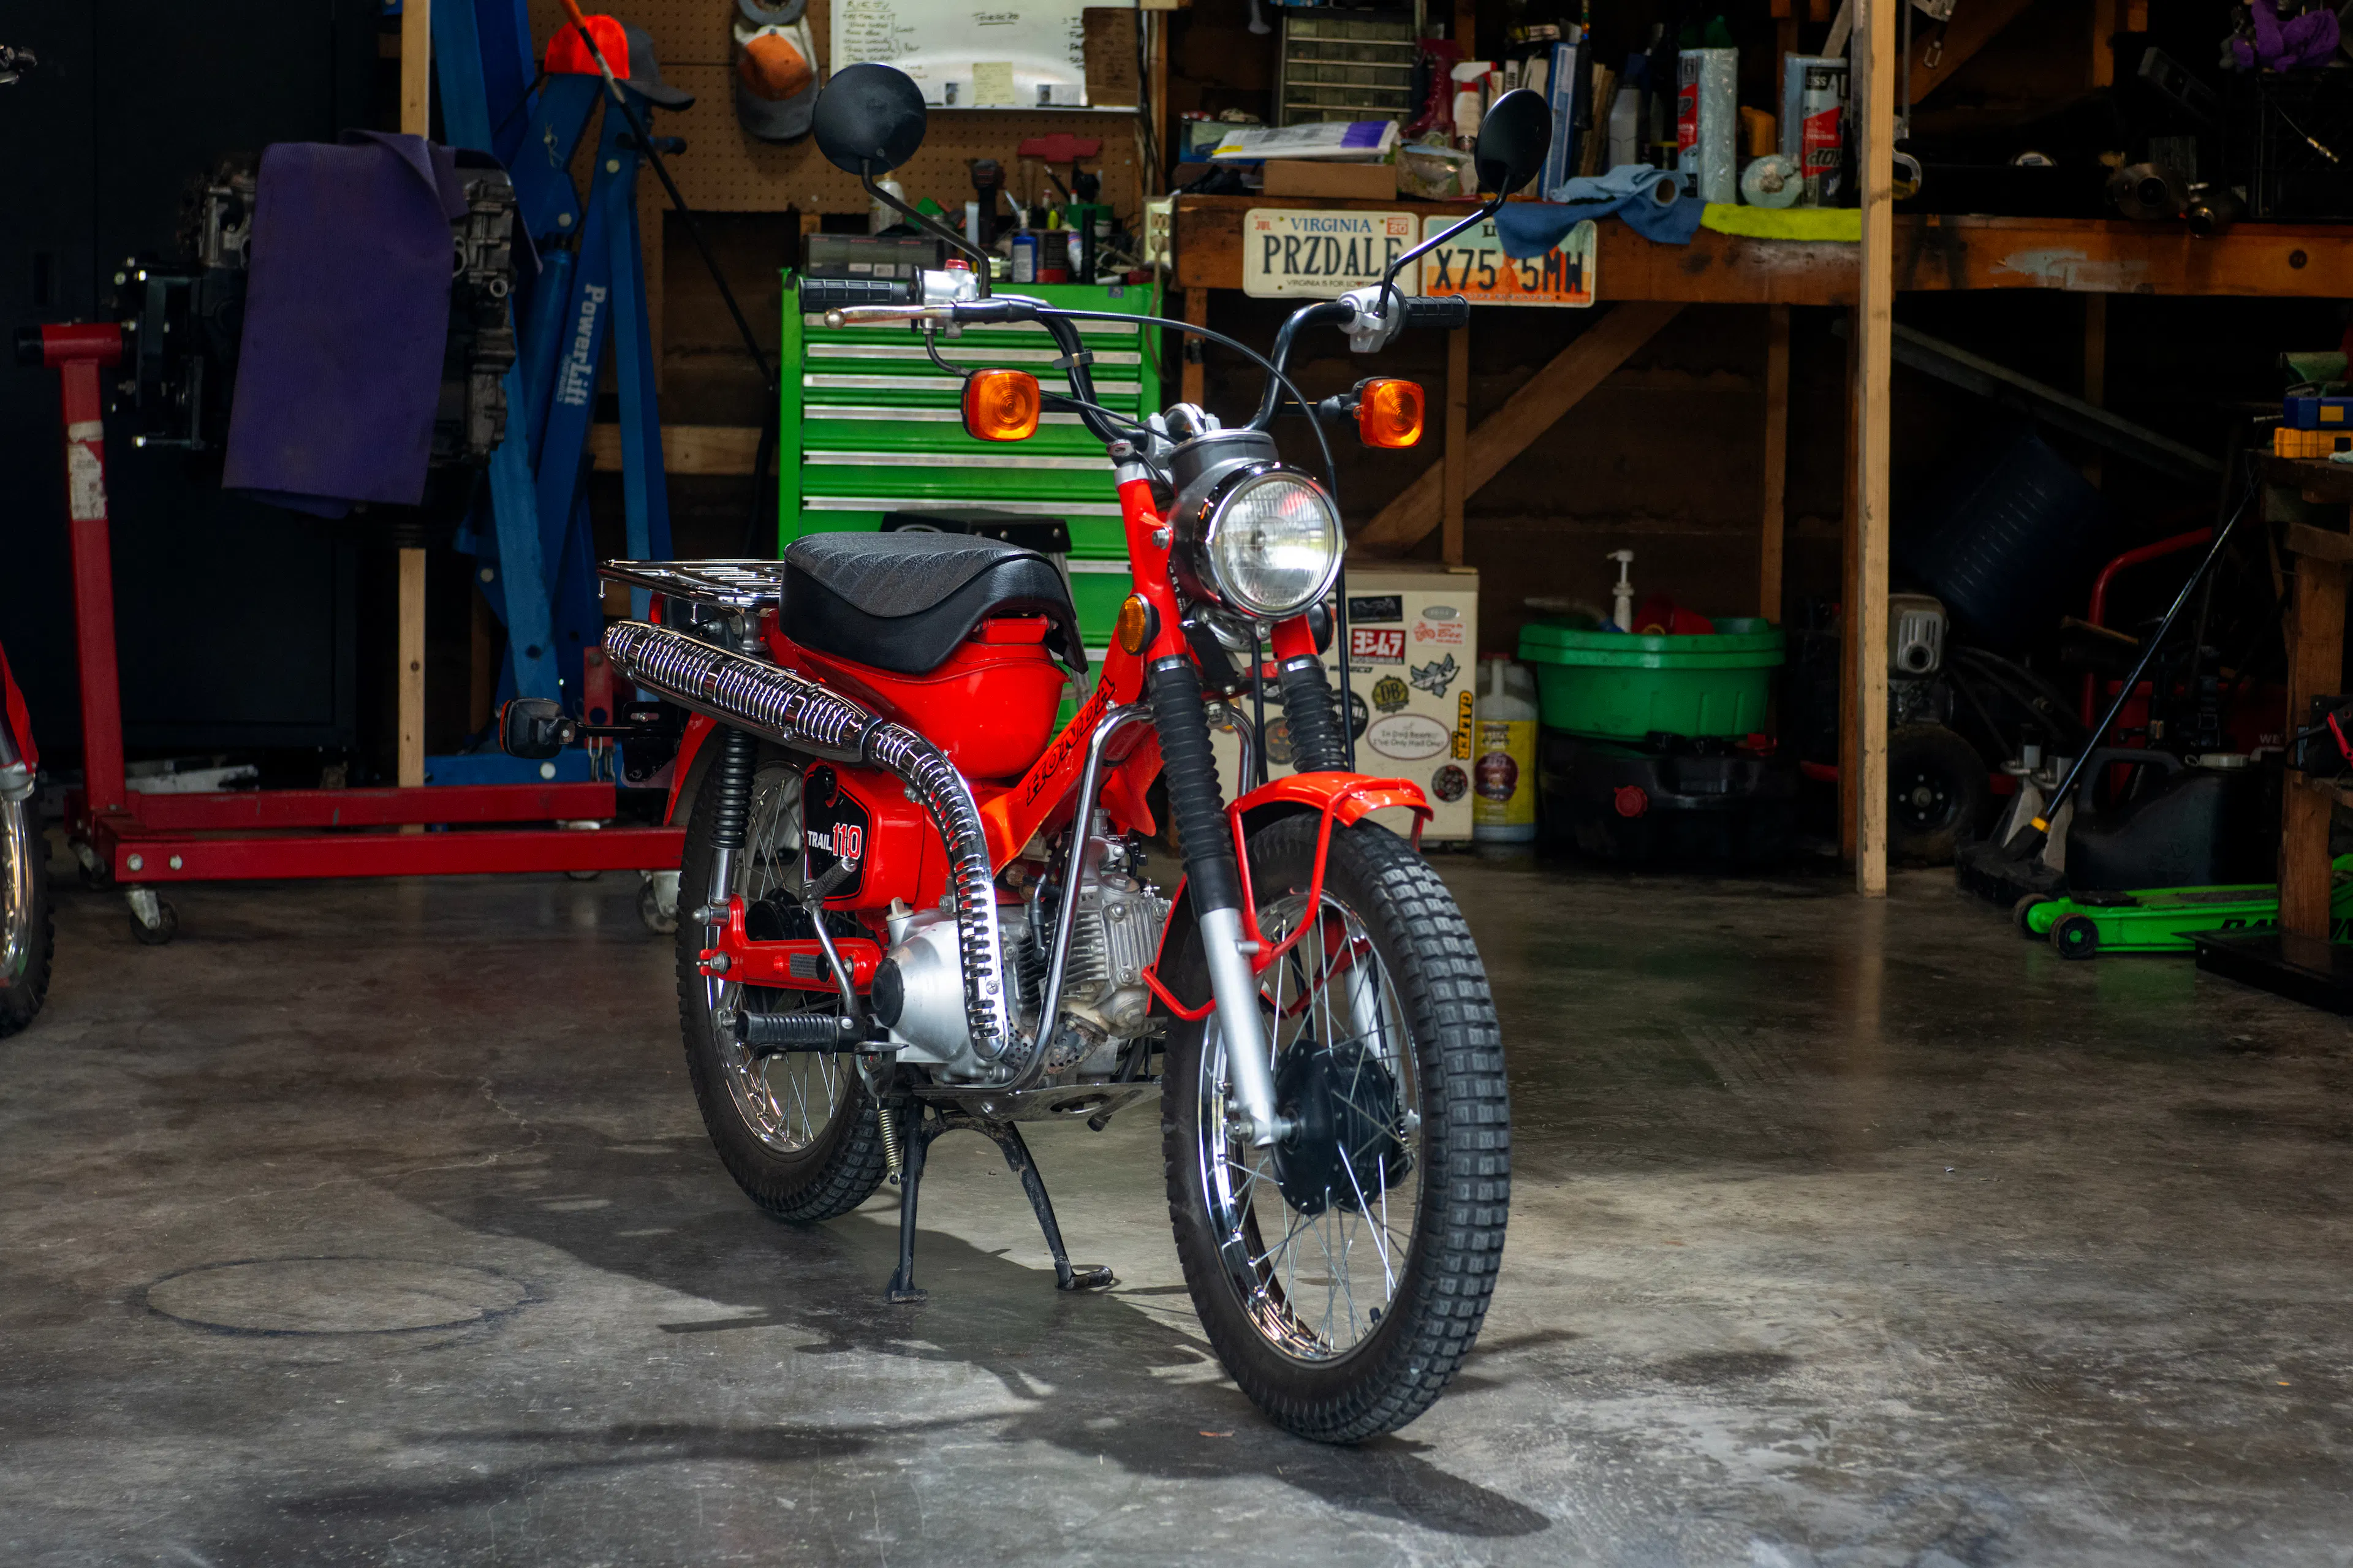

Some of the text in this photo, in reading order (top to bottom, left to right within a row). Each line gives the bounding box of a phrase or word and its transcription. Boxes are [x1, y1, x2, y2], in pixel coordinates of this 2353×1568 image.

[1290, 218, 1373, 233] VIRGINIA
[1389, 224, 1408, 234] 20
[1262, 235, 1403, 277] PRZDALE
[1434, 248, 1497, 291] X75
[1286, 279, 1320, 287] VIRGINIA
[564, 283, 608, 406] PowerLift
[1352, 629, 1404, 657] ヨシムラ
[1381, 683, 1401, 701] DB
[1026, 674, 1116, 807] HONDA
[1457, 692, 1474, 760] GALFER
[807, 822, 863, 860] TRAIL 110
